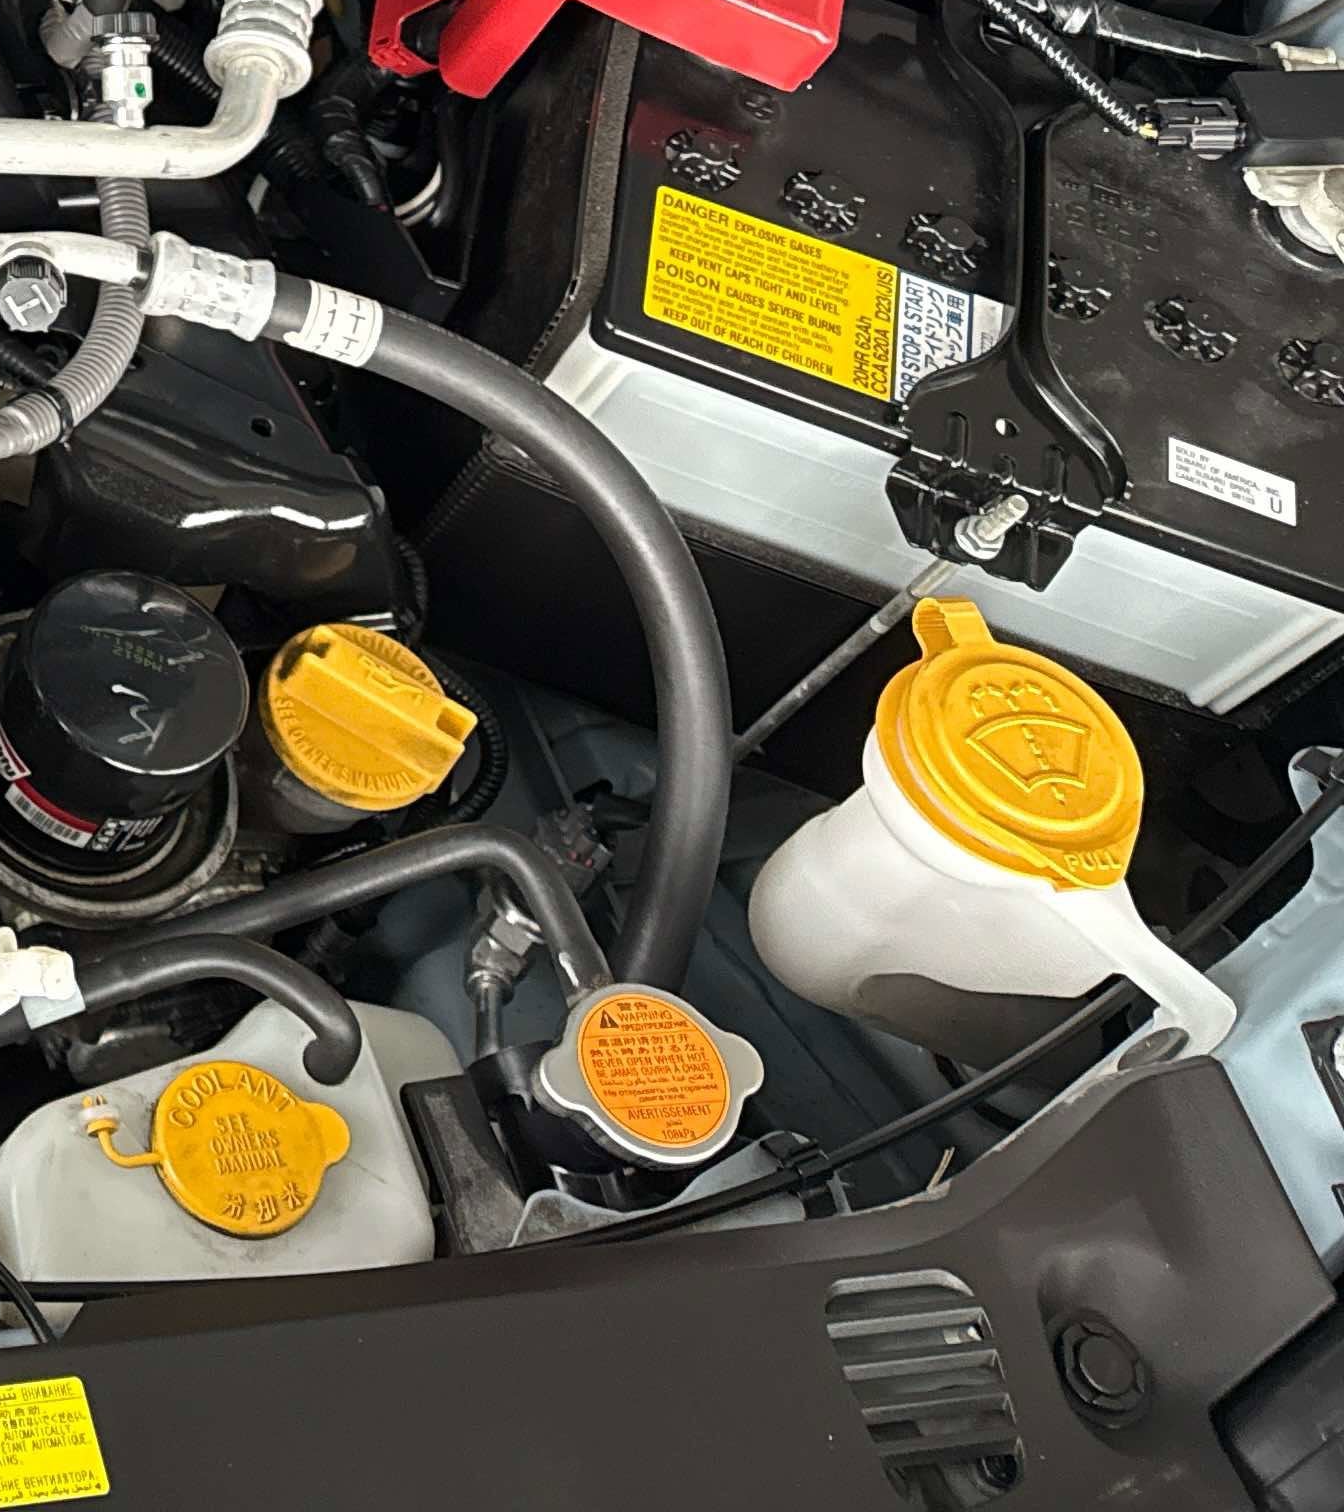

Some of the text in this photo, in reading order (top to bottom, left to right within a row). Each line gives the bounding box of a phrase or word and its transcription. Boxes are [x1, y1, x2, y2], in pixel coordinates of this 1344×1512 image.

[662, 192, 821, 259] DANGER EXPLOSIVE GASES
[669, 247, 840, 316] KEEP VENT CAPS TIGHT AND LEVEL
[5, 284, 54, 327] H
[654, 259, 841, 336] POISON CAUSES SEVERE BURNS
[905, 278, 924, 323] START
[662, 306, 833, 376] KEEP OUT OF REACH OF CHILDREN
[871, 267, 893, 394] CCA 620A D23(JIS)
[905, 325, 921, 335] &
[925, 287, 944, 370] アイドリング
[853, 316, 872, 389] 20HR 62Ah
[902, 338, 921, 372] STOP
[1269, 496, 1282, 515] U
[350, 771, 418, 793] MANUAL
[1063, 851, 1122, 873] PULL
[617, 1007, 672, 1023] WARNING
[591, 1056, 622, 1068] NEVER
[626, 1056, 652, 1067] OPEN
[653, 1053, 683, 1064] WHEN
[169, 1070, 296, 1127] COOLANT
[214, 1113, 249, 1134] SEE
[626, 1102, 712, 1122] AVERTISSEMENT
[210, 1130, 280, 1156] OWNERS
[214, 1150, 286, 1176] MANUAL
[21, 1383, 73, 1401] ВНИМАНИЕ
[1, 1440, 26, 1453] ÉTANT
